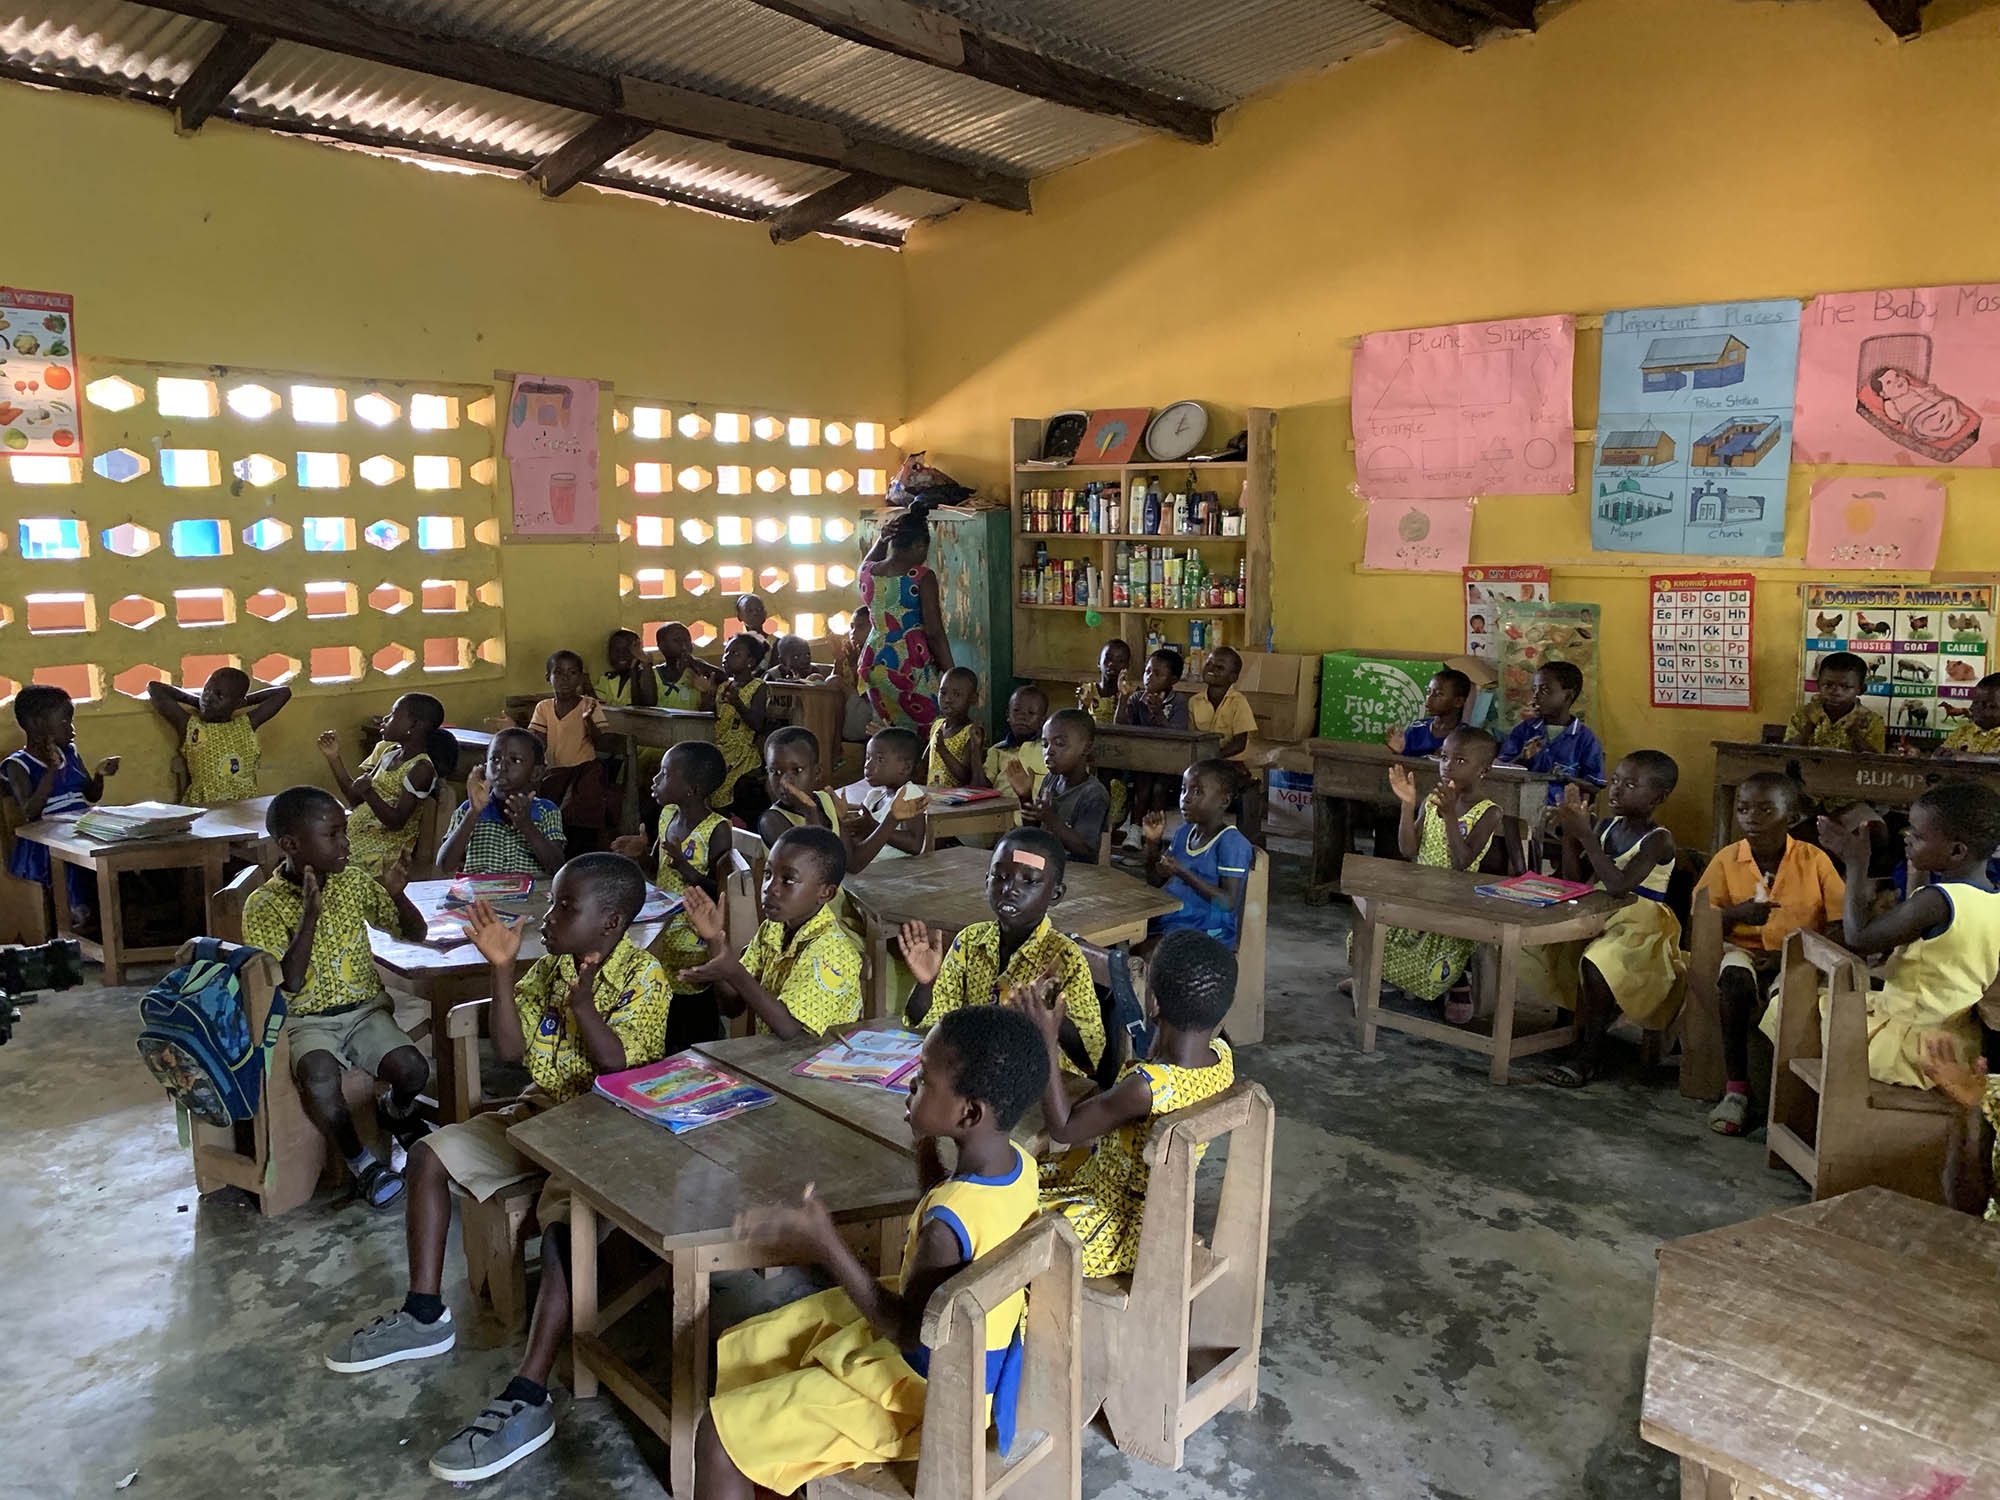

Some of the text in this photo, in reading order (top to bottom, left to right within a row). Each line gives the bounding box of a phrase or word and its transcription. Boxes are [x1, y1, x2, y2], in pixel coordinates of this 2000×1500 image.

[1873, 288, 1938, 332] Baby
[1617, 306, 1785, 340] Important Places
[1486, 325, 1551, 351] Shapes
[1489, 568, 1543, 579] MY BODY
[1708, 579, 1747, 588] ALPHABET
[1657, 592, 1746, 603] Aa Bb Cc Dd
[1824, 590, 1973, 606] DOMESTIC ANIMALS
[1657, 609, 1746, 622] Ee Ff Gg Hh
[1660, 626, 1743, 638] Ii Jj Kk Ll
[1657, 644, 1674, 652] Mm
[1679, 643, 1696, 652] Nn
[1728, 643, 1745, 654] Pp
[1850, 640, 1892, 651] ROOSTER
[1903, 642, 1928, 651] GOAT
[1946, 643, 1979, 653] CAMEL
[1658, 658, 1743, 669] Qq Rr Ss Tt
[1658, 674, 1745, 685] Uu Vv Ww Xx
[1658, 690, 1697, 700] Yy Zz
[1894, 685, 1933, 696] DONKEY
[1950, 688, 1969, 697] RAT
[1344, 694, 1385, 715] Five
[1889, 728, 1932, 739] ELEPHANT
